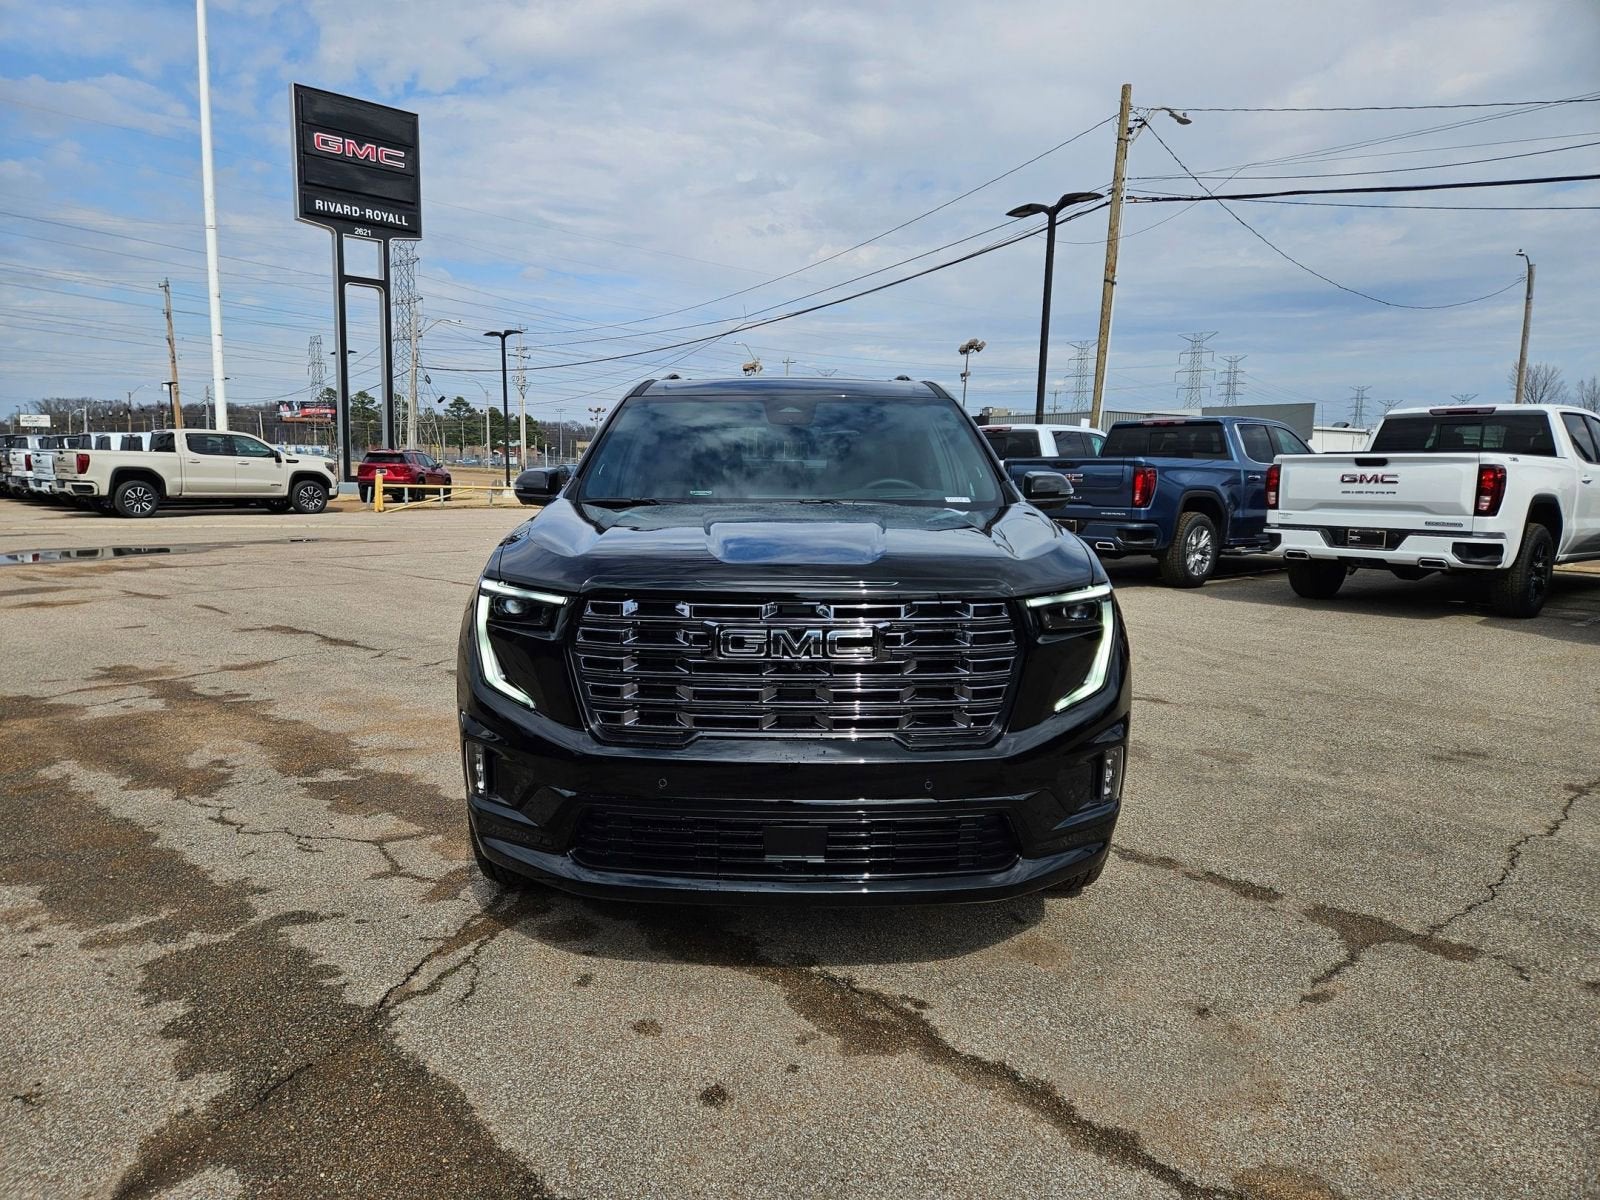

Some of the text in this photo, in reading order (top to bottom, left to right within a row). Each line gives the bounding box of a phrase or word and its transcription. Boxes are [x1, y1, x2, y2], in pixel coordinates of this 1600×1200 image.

[314, 133, 405, 168] GMC
[315, 199, 408, 226] RIVARD-ROYALL
[354, 227, 371, 237] 2621
[1341, 474, 1399, 484] GMC
[719, 629, 874, 658] GMC
